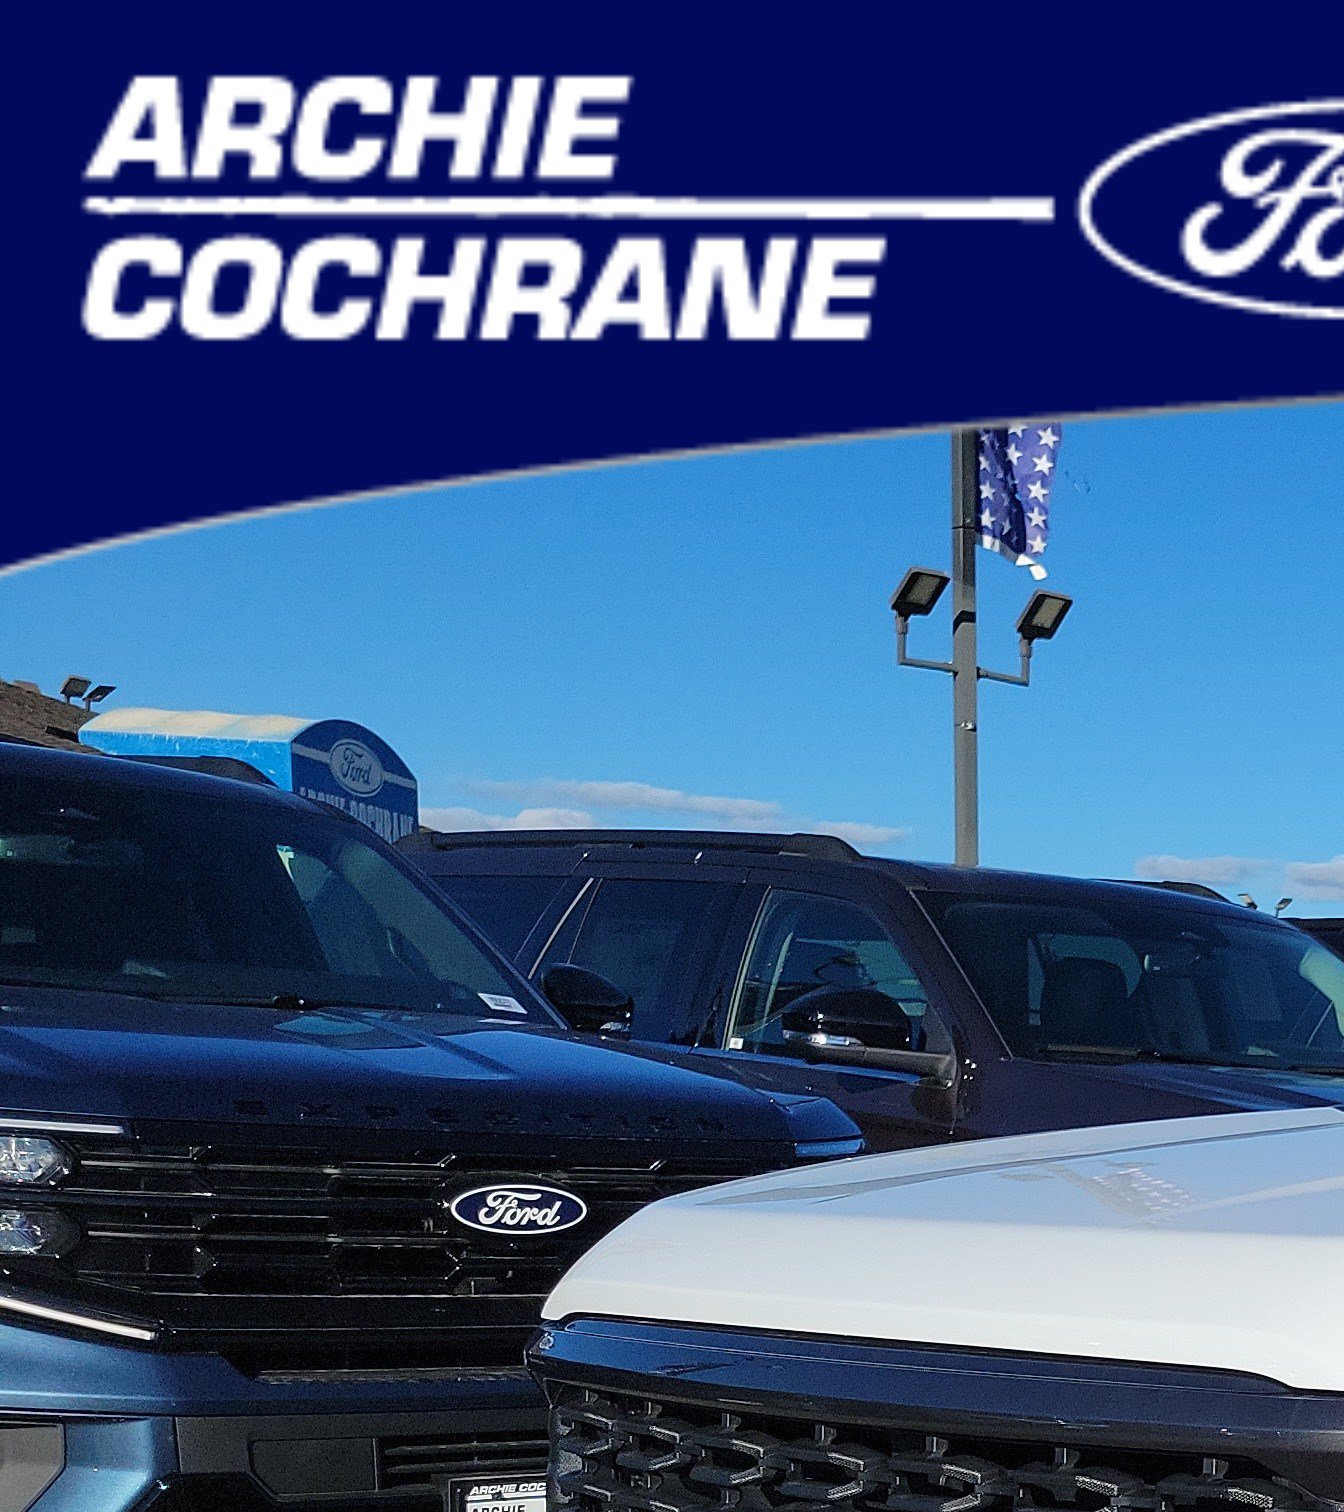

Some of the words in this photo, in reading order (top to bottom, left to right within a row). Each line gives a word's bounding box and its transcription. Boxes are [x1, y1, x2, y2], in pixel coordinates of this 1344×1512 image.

[341, 747, 372, 786] Ford
[478, 1190, 562, 1226] Ford
[470, 1484, 518, 1496] ARCHIE
